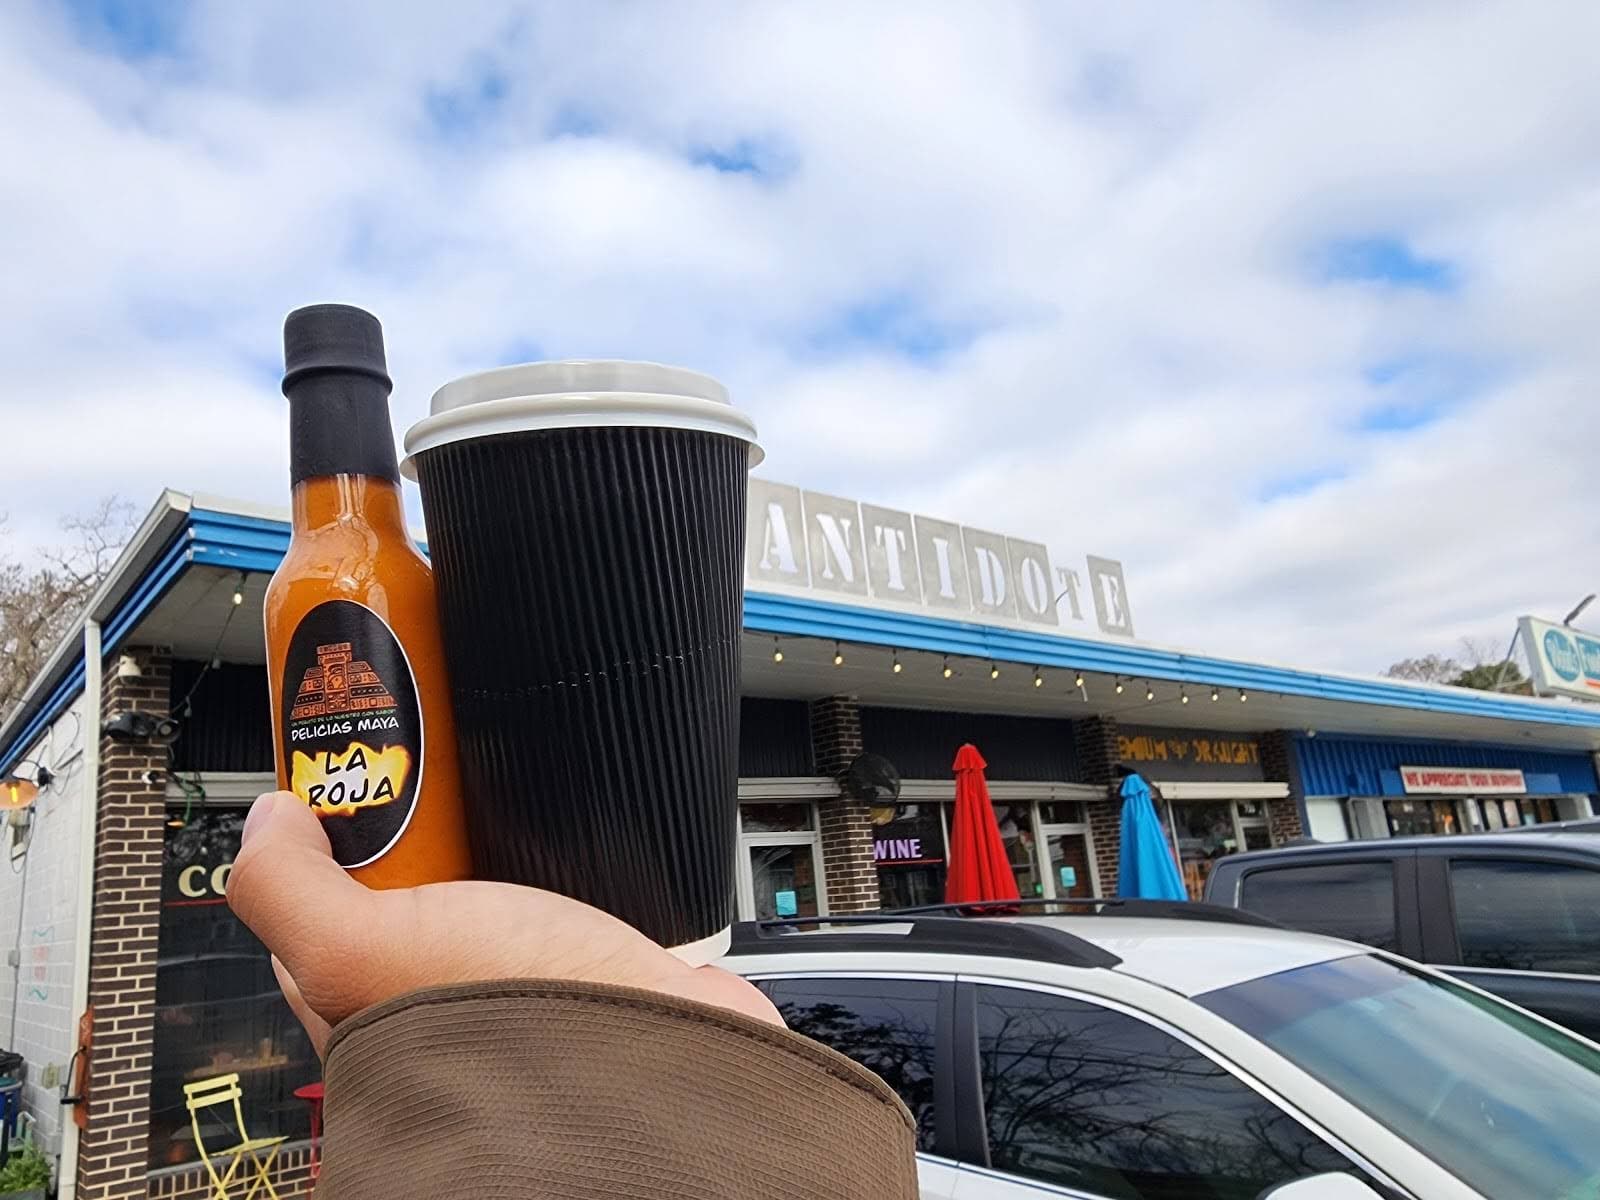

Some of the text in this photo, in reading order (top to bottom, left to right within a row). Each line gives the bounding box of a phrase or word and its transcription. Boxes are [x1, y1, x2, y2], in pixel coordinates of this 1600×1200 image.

[760, 503, 1126, 627] ANTIDOTE
[291, 716, 399, 741] DELICIAS MAYA
[326, 747, 367, 775] LA
[308, 775, 394, 808] ROJA
[873, 838, 922, 859] WINE
